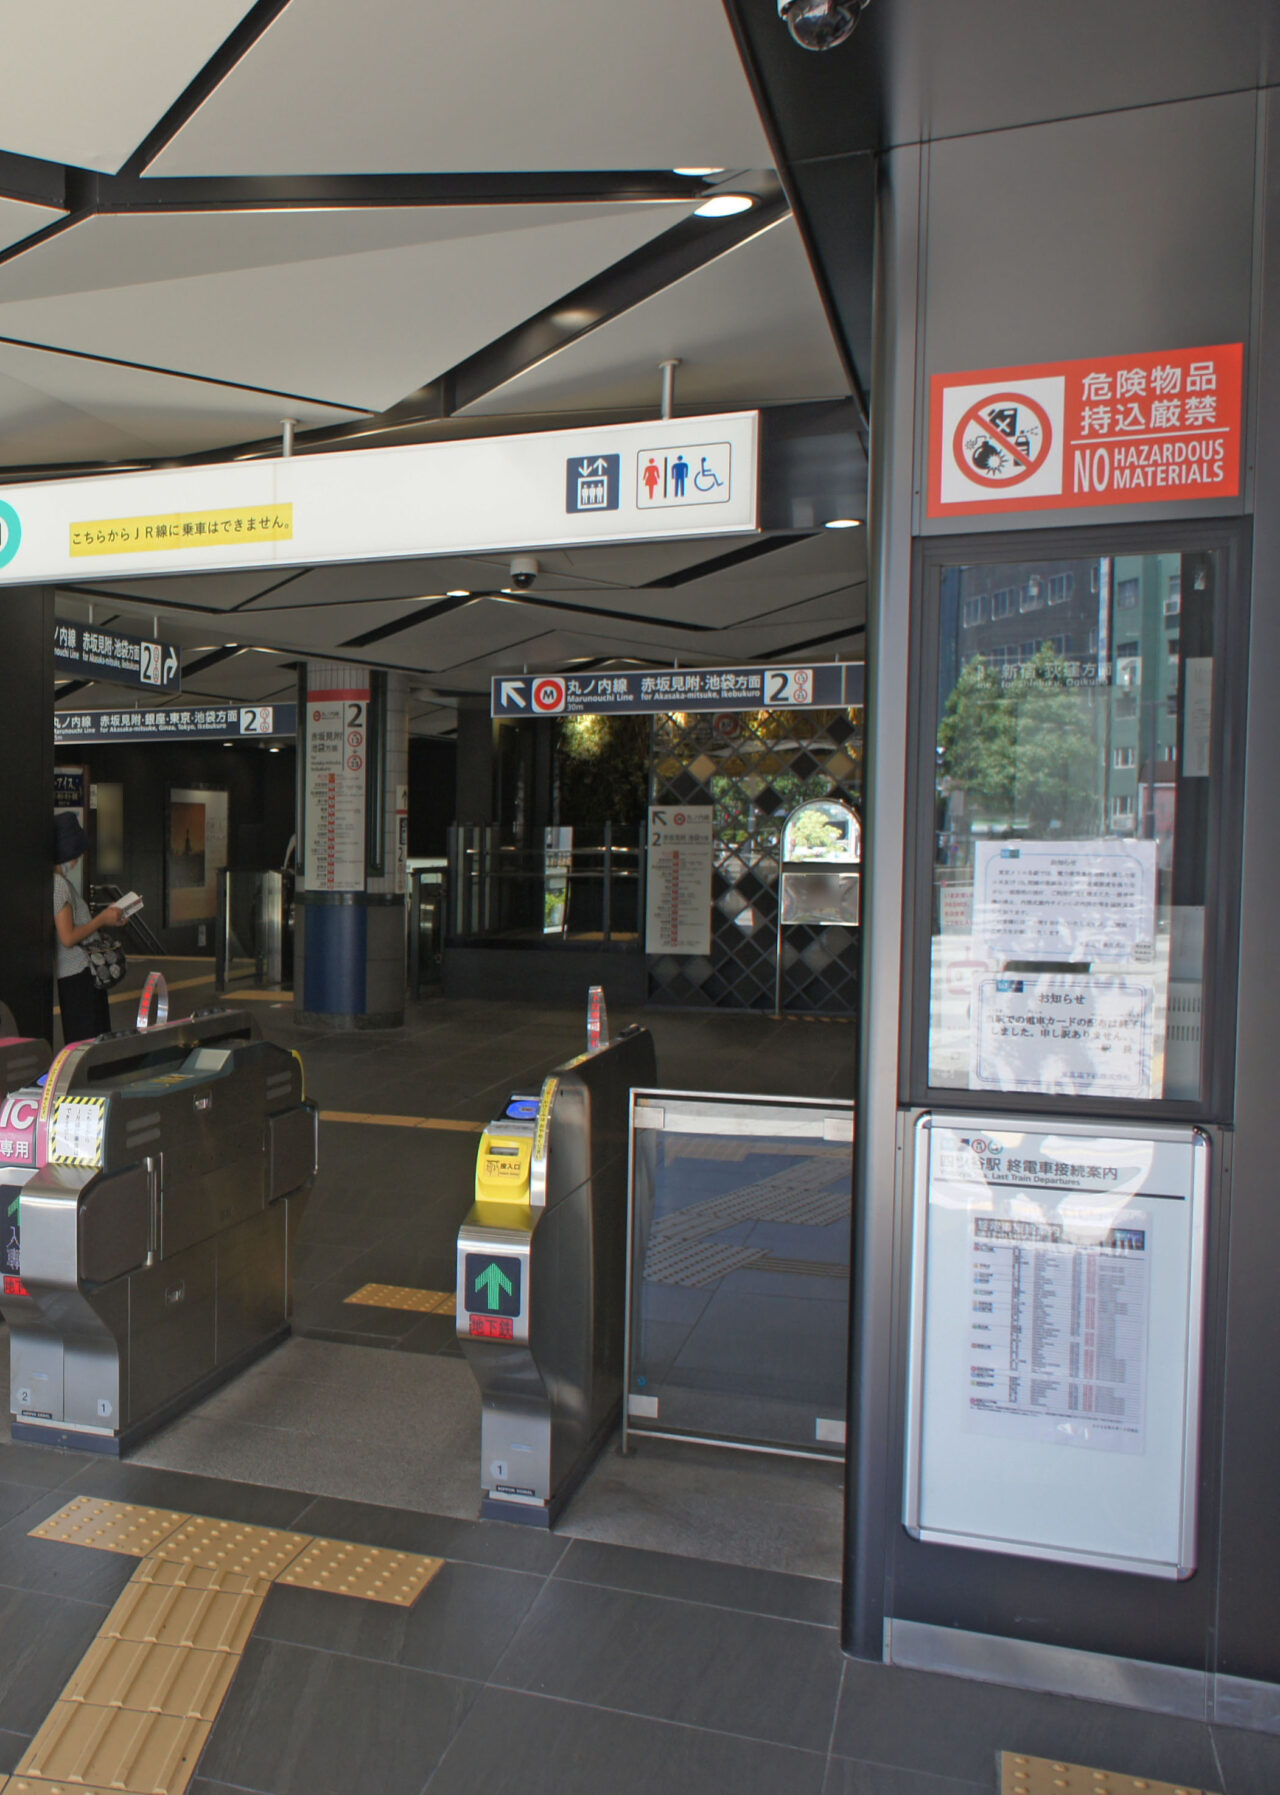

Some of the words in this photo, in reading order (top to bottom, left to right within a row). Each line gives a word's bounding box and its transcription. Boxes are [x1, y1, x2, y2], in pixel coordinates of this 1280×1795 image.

[1081, 361, 1217, 401] 危険物品
[1080, 396, 1217, 436] 持込厳禁
[1073, 448, 1110, 493] NO
[1113, 439, 1225, 468] HAZARDOUS
[1113, 461, 1225, 491] MATERIALS
[142, 645, 152, 681] 2
[567, 676, 628, 695] 丸ノ内線
[770, 672, 789, 701] 2
[567, 694, 614, 703] Marunouchi
[616, 693, 634, 702] Line
[641, 691, 652, 699] for
[244, 710, 257, 732] 2
[347, 703, 363, 727] 2
[652, 832, 661, 846] 2
[1039, 993, 1086, 1005] お知らせ
[0, 1100, 39, 1129] IC
[0, 1140, 30, 1159] 専用
[992, 1173, 1007, 1182] Last
[1008, 1174, 1029, 1183] Train
[1033, 1176, 1081, 1187] Departures
[1006, 1160, 1118, 1181] 終電車接続案内
[471, 1317, 514, 1339] 地下鉄
[22, 1391, 28, 1401] 2
[101, 1402, 107, 1413] 1
[497, 1464, 503, 1476] 1
